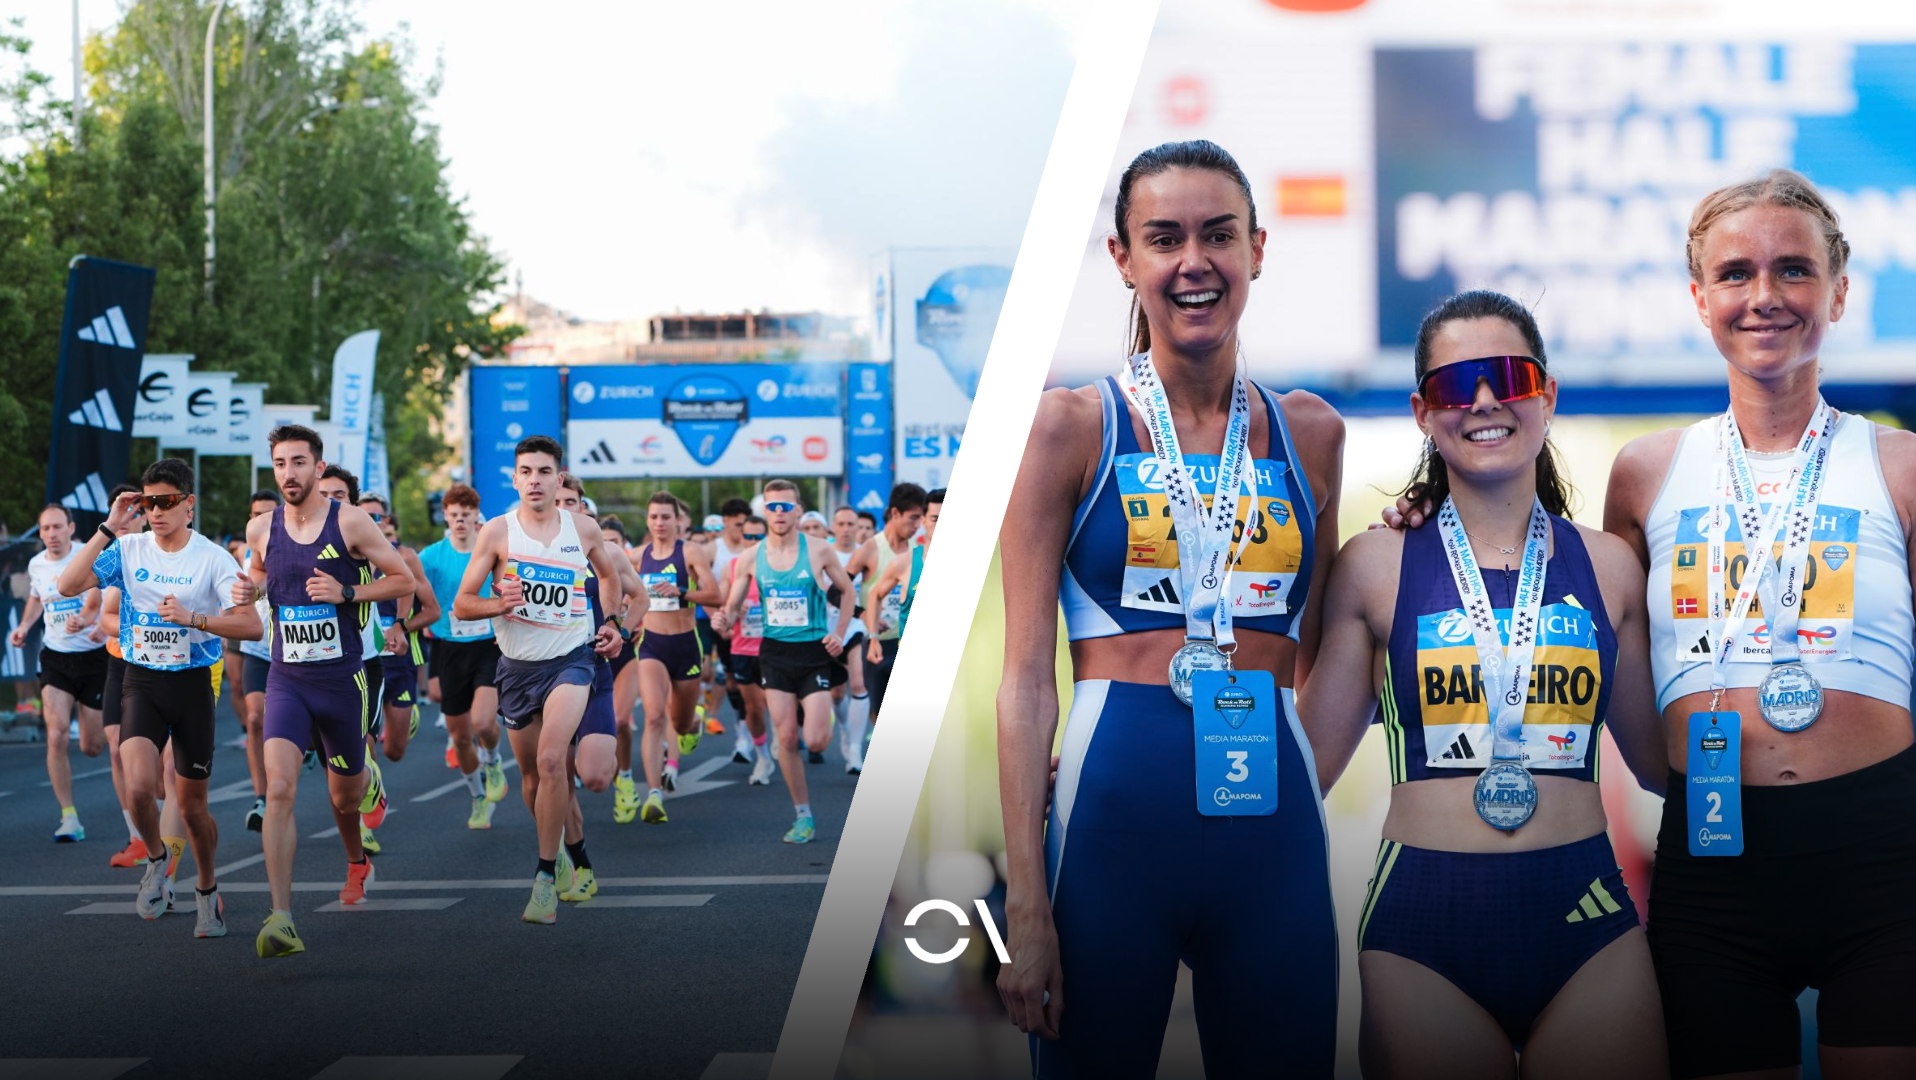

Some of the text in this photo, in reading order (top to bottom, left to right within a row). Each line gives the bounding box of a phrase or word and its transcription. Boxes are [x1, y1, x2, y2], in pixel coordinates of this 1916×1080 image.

[1151, 388, 1178, 464] HALF MARATHON
[1220, 414, 1242, 492] HALF MARATHON
[1735, 458, 1754, 504] MARATHON
[1134, 503, 1142, 514] 1
[1795, 488, 1807, 508] HALF
[1209, 550, 1220, 576] MAPOMA
[1453, 528, 1481, 597] HALF MARATHON
[1684, 552, 1690, 563] 1
[153, 574, 192, 584] ZURICH
[539, 570, 569, 580] ZURICH
[1518, 540, 1538, 608] HALF MARATHON
[521, 580, 568, 608] ROJO
[298, 608, 329, 618] ZURICH
[144, 630, 178, 644] 50042
[1424, 664, 1596, 706] BAREIRO
[1513, 665, 1521, 693] MAPOMA
[1762, 690, 1818, 706] MADRID
[1230, 734, 1268, 742] MARATÓN
[1225, 751, 1248, 782] 3
[1480, 788, 1534, 804] MADRID
[1706, 792, 1722, 822] 2
